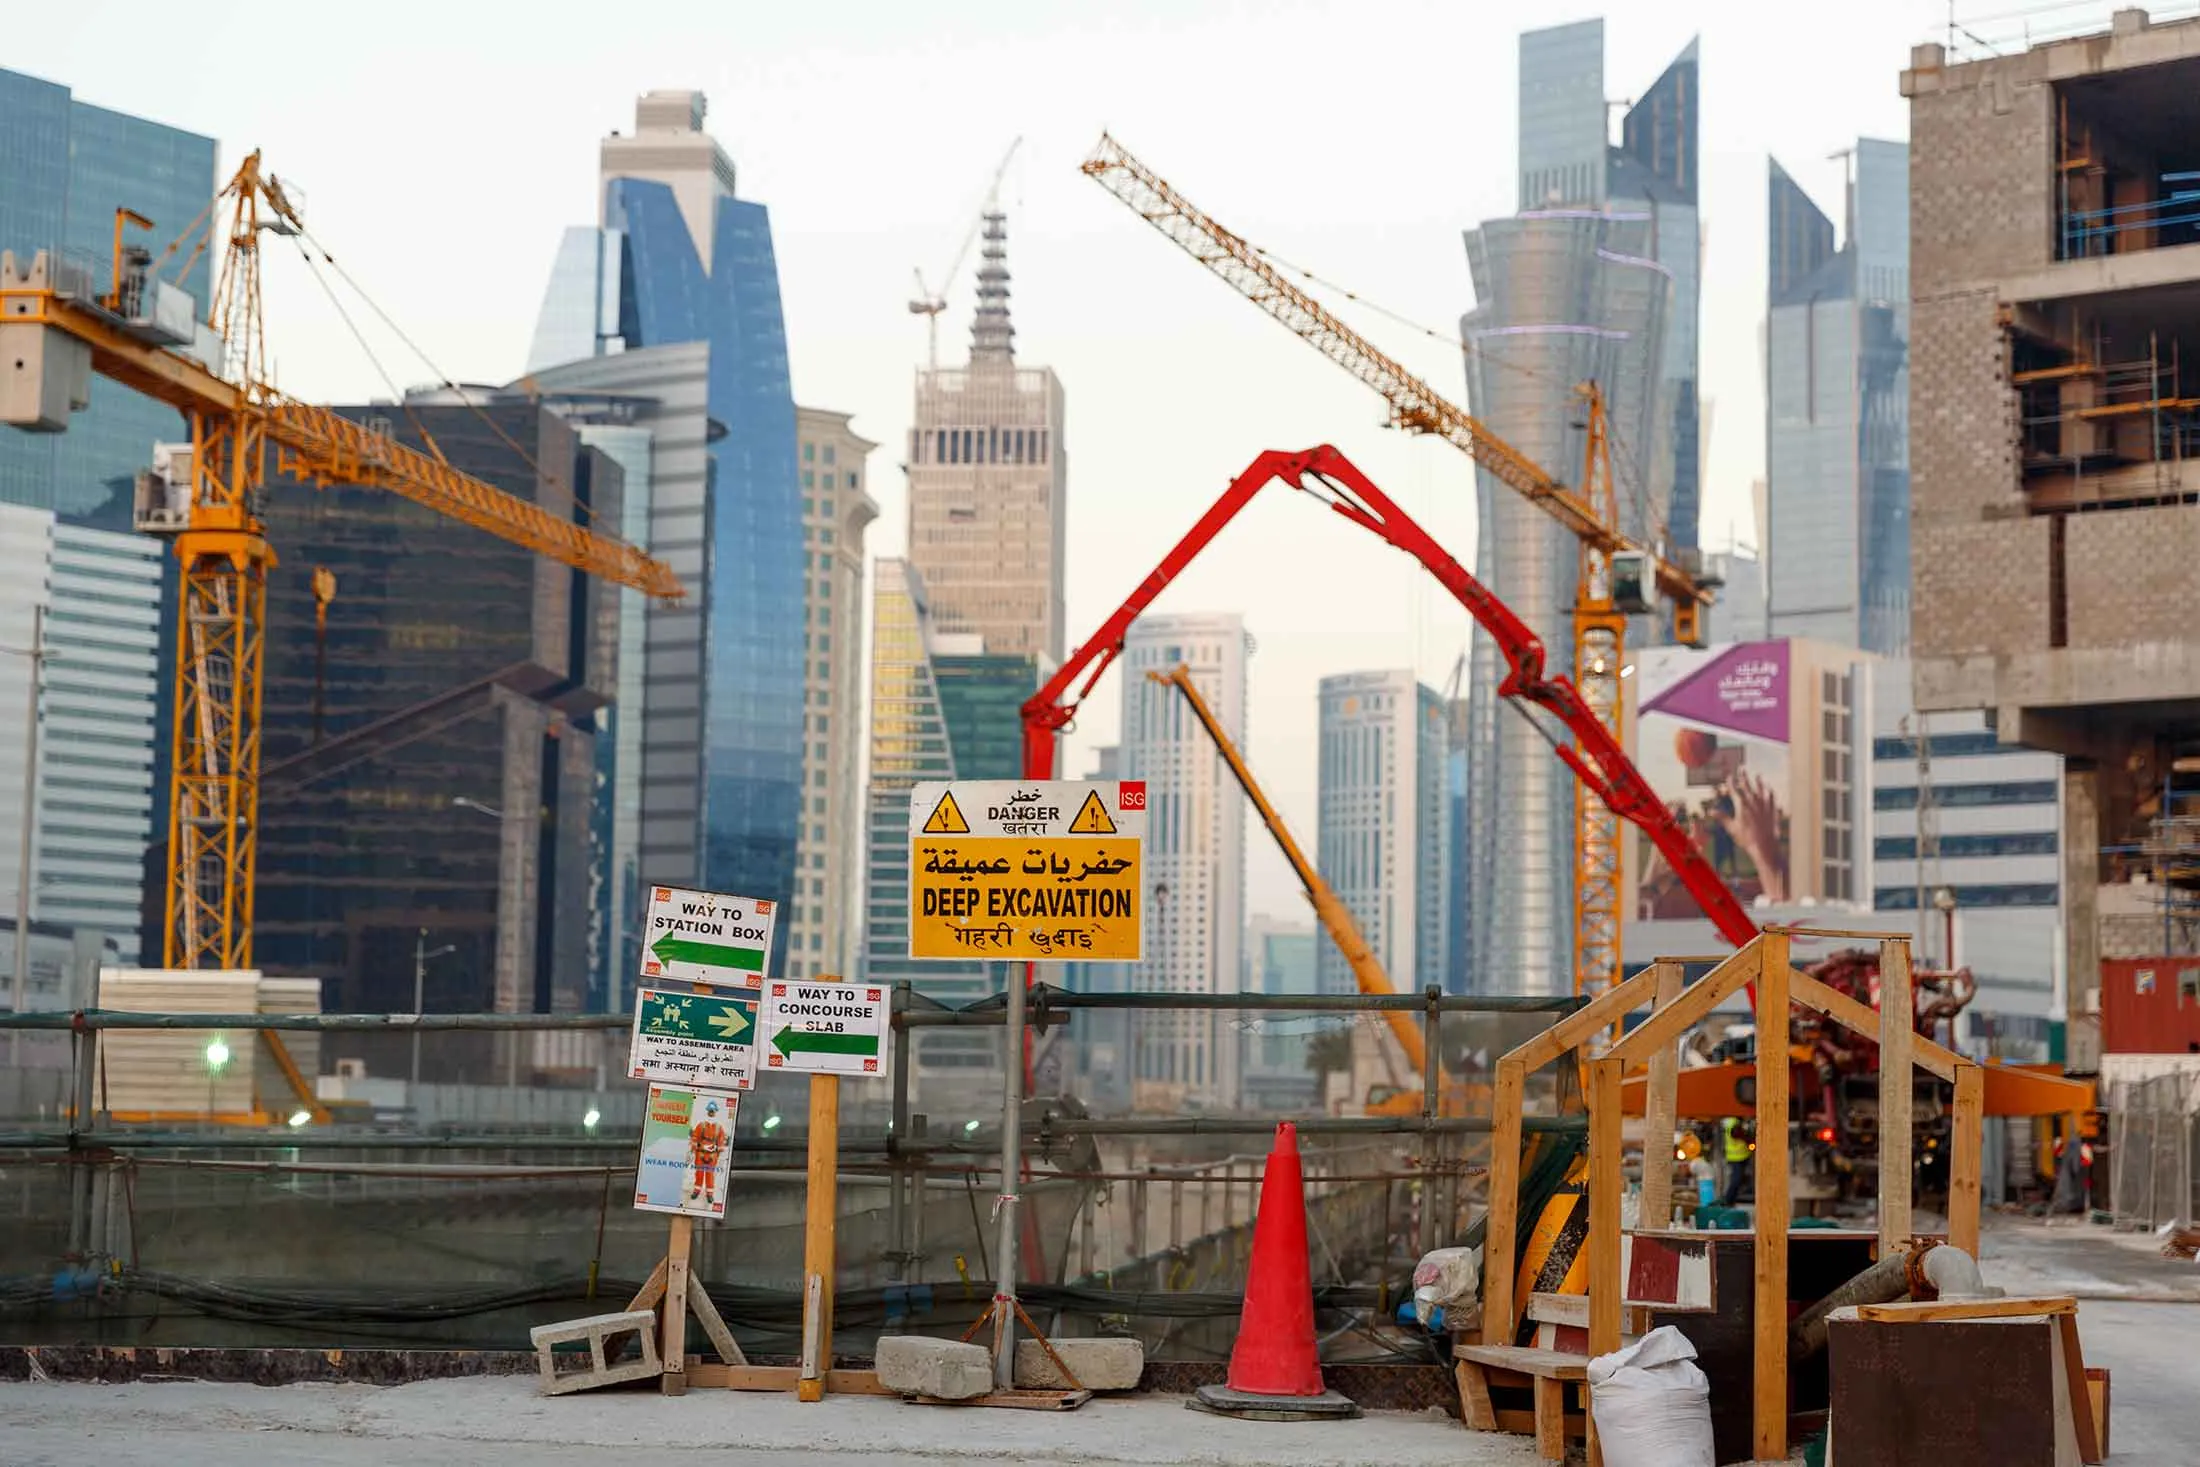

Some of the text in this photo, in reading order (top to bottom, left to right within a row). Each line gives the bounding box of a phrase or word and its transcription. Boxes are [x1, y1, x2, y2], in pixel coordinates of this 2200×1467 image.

[1007, 788, 1042, 806] خطر
[1121, 792, 1145, 806] ISG
[987, 807, 1060, 820] DANGER
[1002, 822, 1048, 835] खतरा
[922, 848, 1132, 883] حفريات عميقة
[923, 888, 1131, 917] DEEP EXCAVATION
[682, 903, 742, 920] WAY TO
[655, 917, 766, 941] STATION BOX
[798, 988, 854, 1001] WAY TO
[779, 1003, 873, 1018] CONCOURSE
[805, 1021, 844, 1032] SLAB
[646, 1036, 664, 1044] WAY
[679, 1040, 721, 1050] ASSEMBLY
[723, 1044, 745, 1052] AREA
[645, 1158, 667, 1166] WEAR
[668, 1161, 689, 1169] BODY
